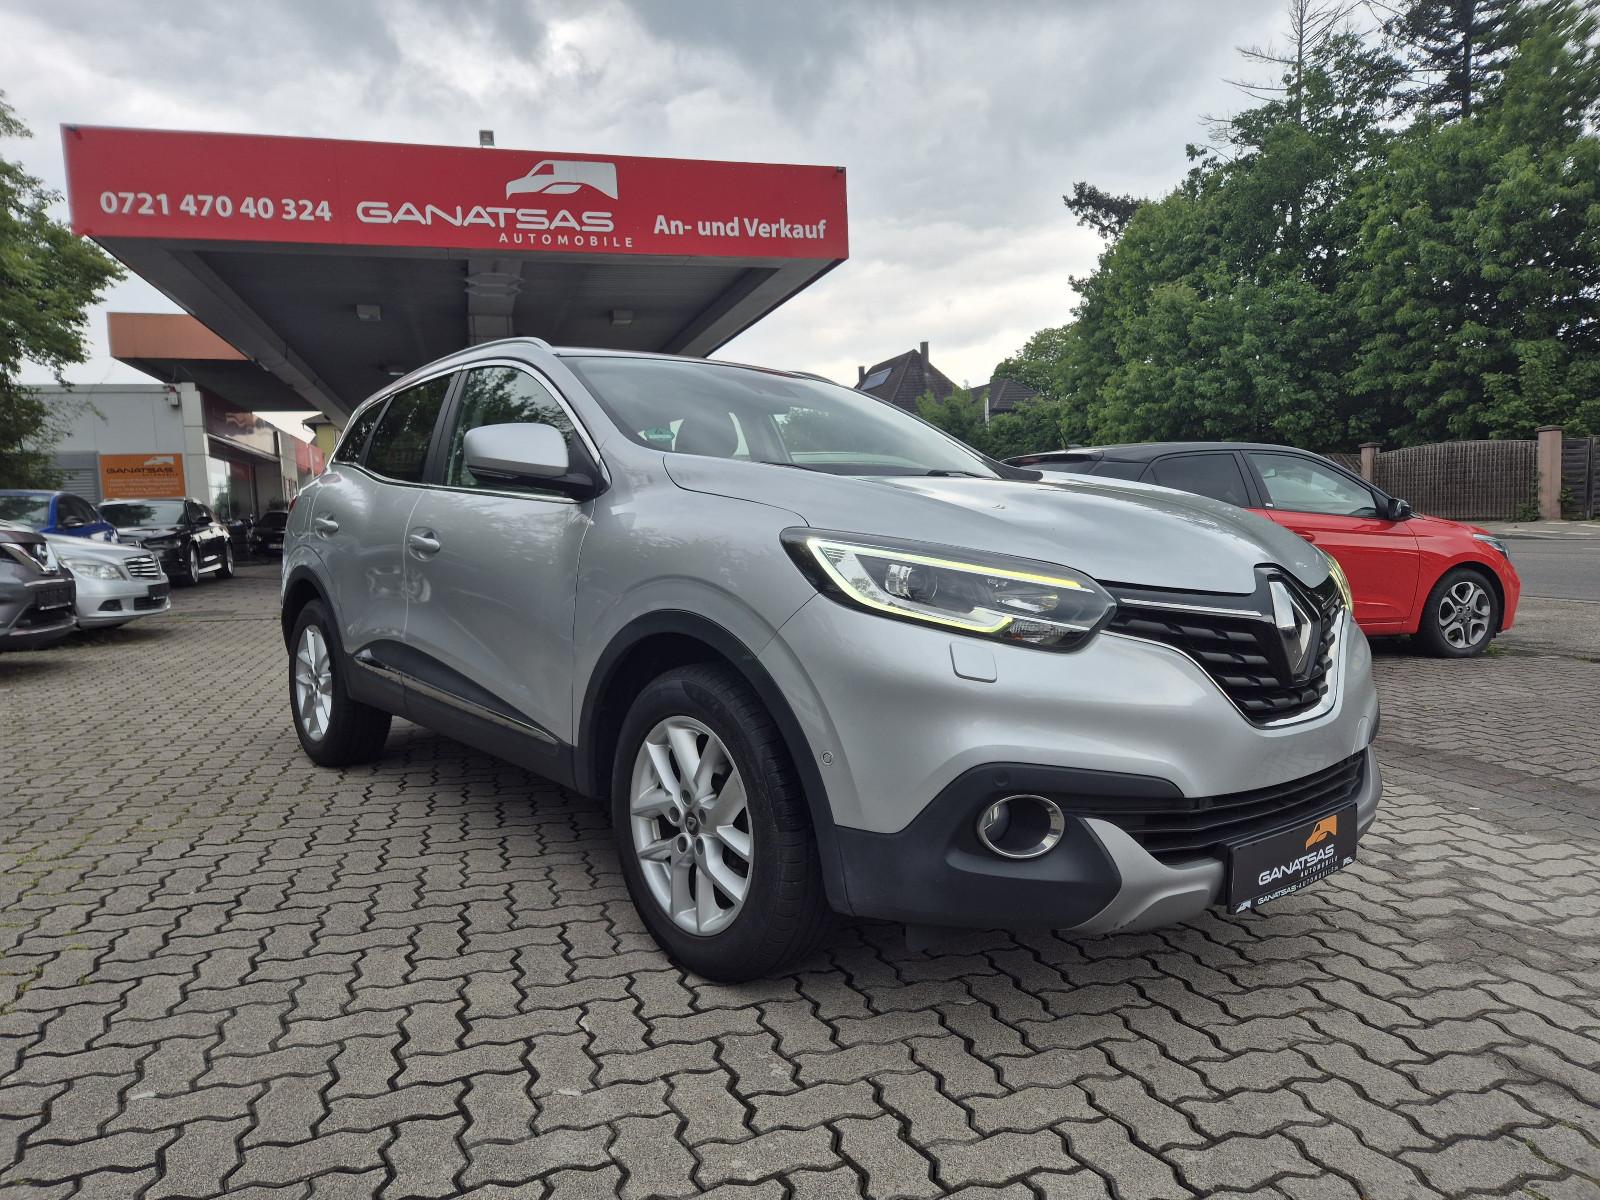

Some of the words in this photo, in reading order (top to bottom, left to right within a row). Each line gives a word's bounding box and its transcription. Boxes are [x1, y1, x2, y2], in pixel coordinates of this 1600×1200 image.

[99, 191, 169, 215] 0721
[179, 194, 233, 217] 470
[239, 196, 274, 219] 40
[281, 198, 332, 222] 324
[356, 201, 615, 233] GANATSAS
[498, 232, 633, 248] AUTOMOBILE
[653, 214, 692, 235] An-
[697, 216, 740, 237] und
[743, 217, 827, 239] Verkauf
[1258, 843, 1335, 885] GANATSAS
